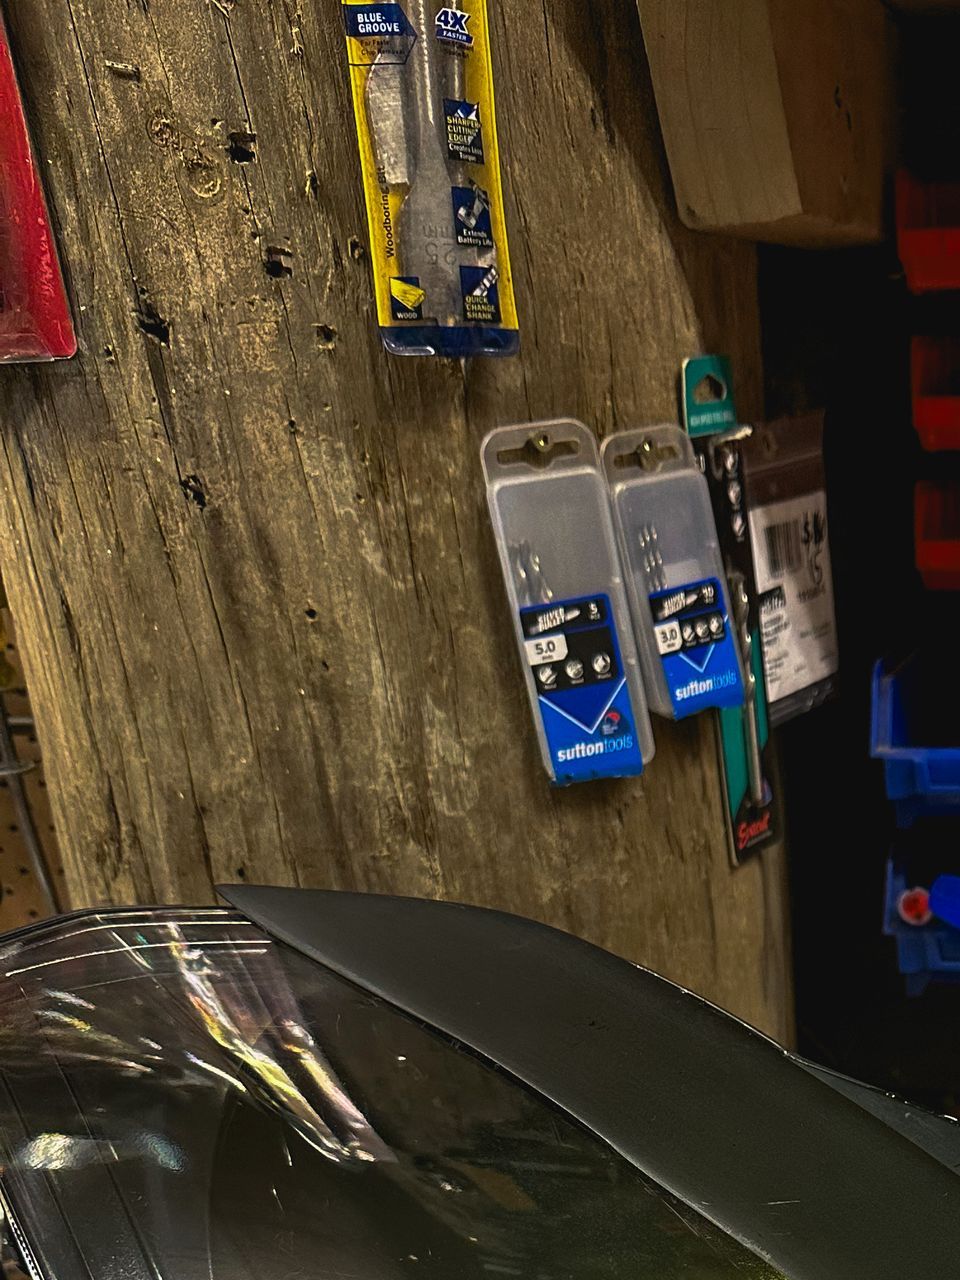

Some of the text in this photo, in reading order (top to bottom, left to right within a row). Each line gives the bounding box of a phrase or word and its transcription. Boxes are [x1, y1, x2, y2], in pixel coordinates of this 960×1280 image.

[357, 12, 386, 23] BLUE-
[435, 8, 471, 34] 4X
[358, 22, 400, 33] GROOVE
[442, 30, 468, 41] FASTER
[380, 185, 395, 258] Woodboring
[397, 311, 417, 319] WOOD
[660, 628, 678, 644] 3.0
[535, 640, 556, 656] 5.0
[557, 734, 633, 762] suttontools
